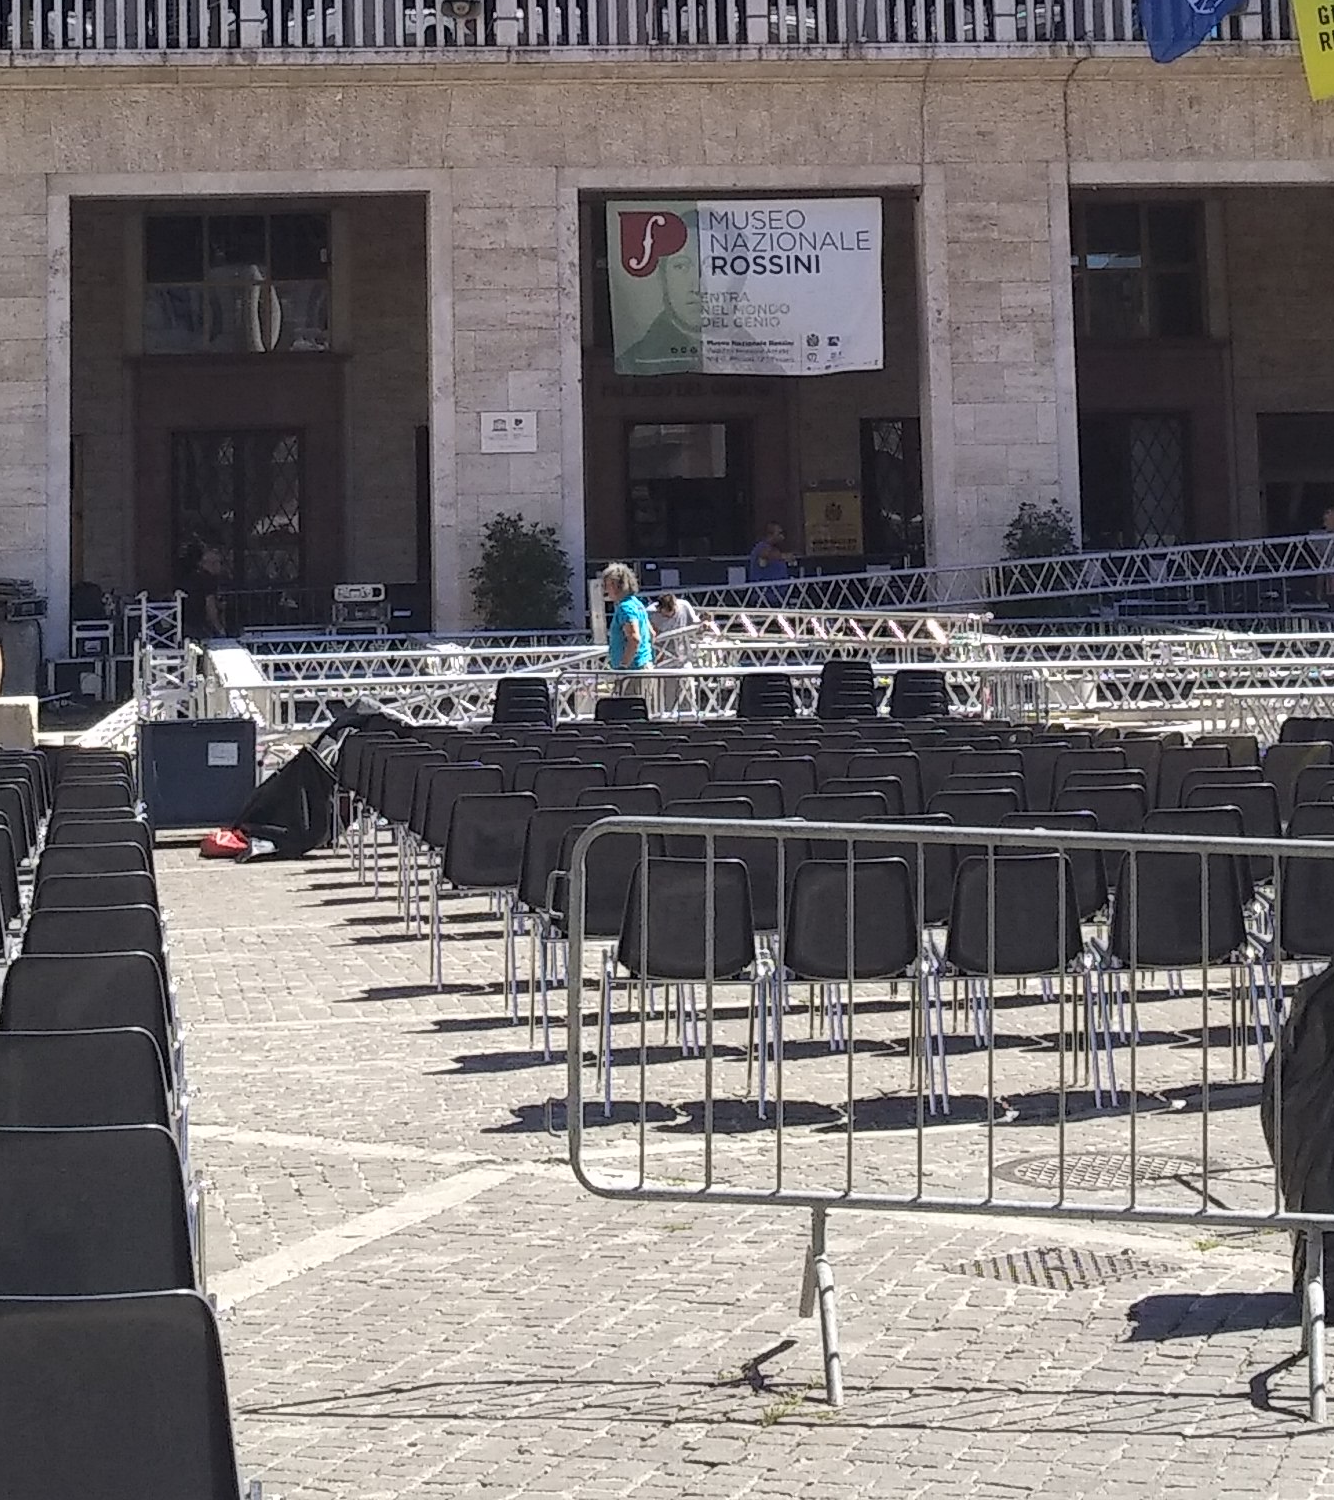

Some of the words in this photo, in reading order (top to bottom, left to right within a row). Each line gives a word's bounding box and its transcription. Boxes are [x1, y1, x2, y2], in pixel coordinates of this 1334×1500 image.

[709, 209, 806, 230] MUSEO
[710, 230, 872, 253] NAZIONALE
[711, 254, 821, 276] ROSSINI
[701, 291, 750, 303] ENTRA
[701, 304, 729, 316] NEL
[733, 303, 790, 316] MONDO
[701, 316, 729, 328] DEL
[733, 316, 781, 328] GENIO
